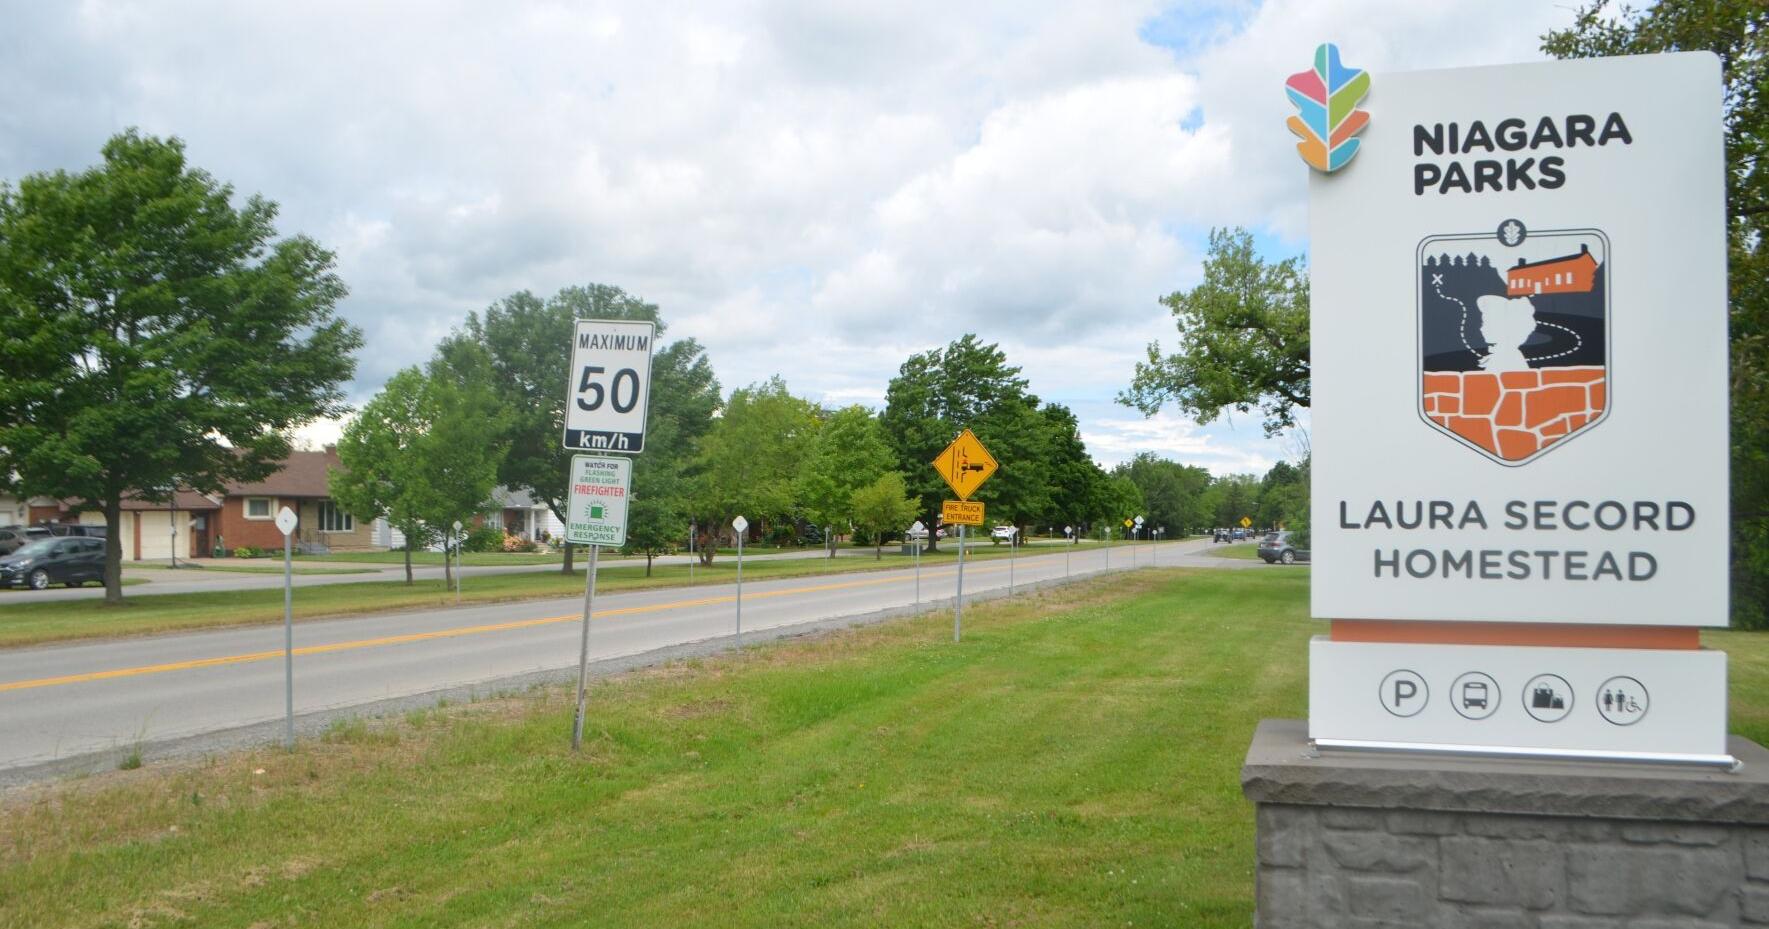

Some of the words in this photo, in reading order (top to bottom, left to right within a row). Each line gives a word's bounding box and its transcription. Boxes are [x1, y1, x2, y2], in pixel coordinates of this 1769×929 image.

[1413, 111, 1633, 156] NIAGARA
[1413, 156, 1566, 196] PARKS
[579, 333, 648, 351] MAXIMUM
[577, 366, 640, 414] 50
[580, 431, 629, 450] km/h
[574, 484, 625, 497] FIREFIGHTER
[945, 504, 958, 512] FIRE
[961, 504, 980, 513] TRUCK
[946, 513, 980, 521] ENTRANCE
[1340, 500, 1488, 530] LAURA
[1504, 500, 1696, 531] SECORD
[570, 523, 621, 533] EMERGENCY
[573, 531, 616, 541] RESPONSE
[1374, 549, 1658, 581] HOMESTEAD
[1394, 680, 1417, 708] P
